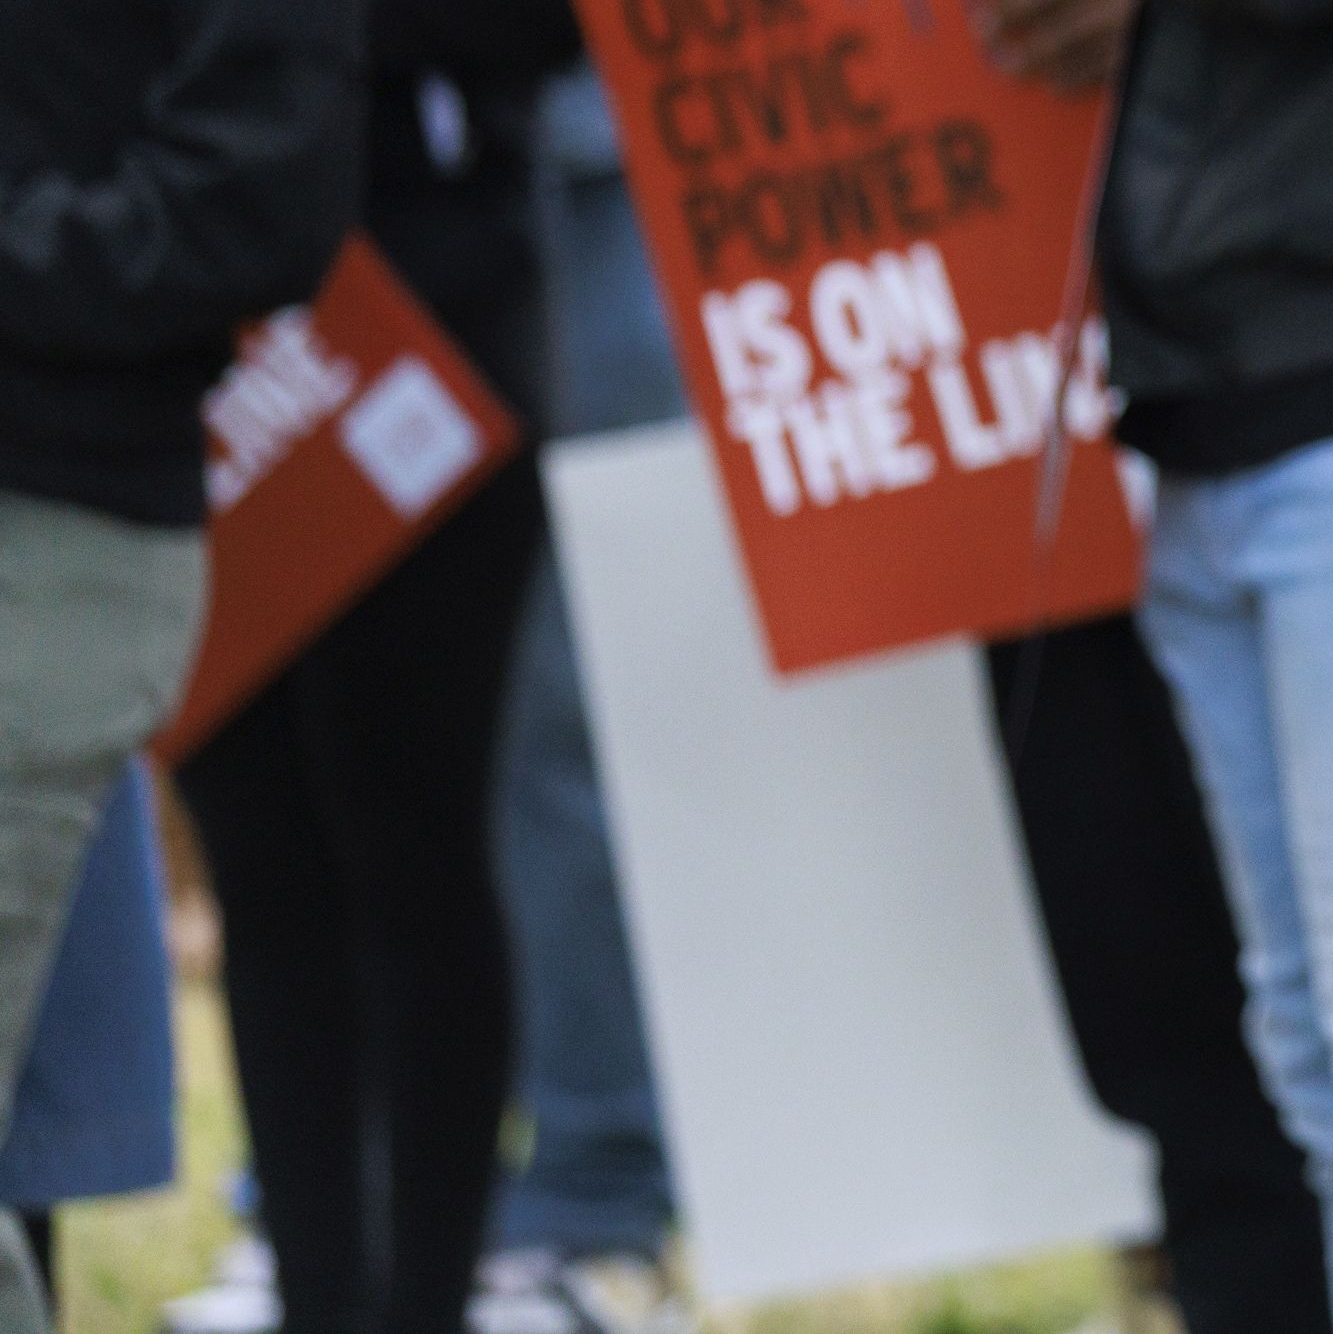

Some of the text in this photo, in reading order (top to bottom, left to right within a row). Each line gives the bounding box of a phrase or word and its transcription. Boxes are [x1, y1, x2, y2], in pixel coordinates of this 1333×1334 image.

[651, 29, 885, 167] CIVIC
[683, 115, 1006, 278] POWER
[701, 239, 968, 408] IS ON
[724, 371, 938, 517] THE
